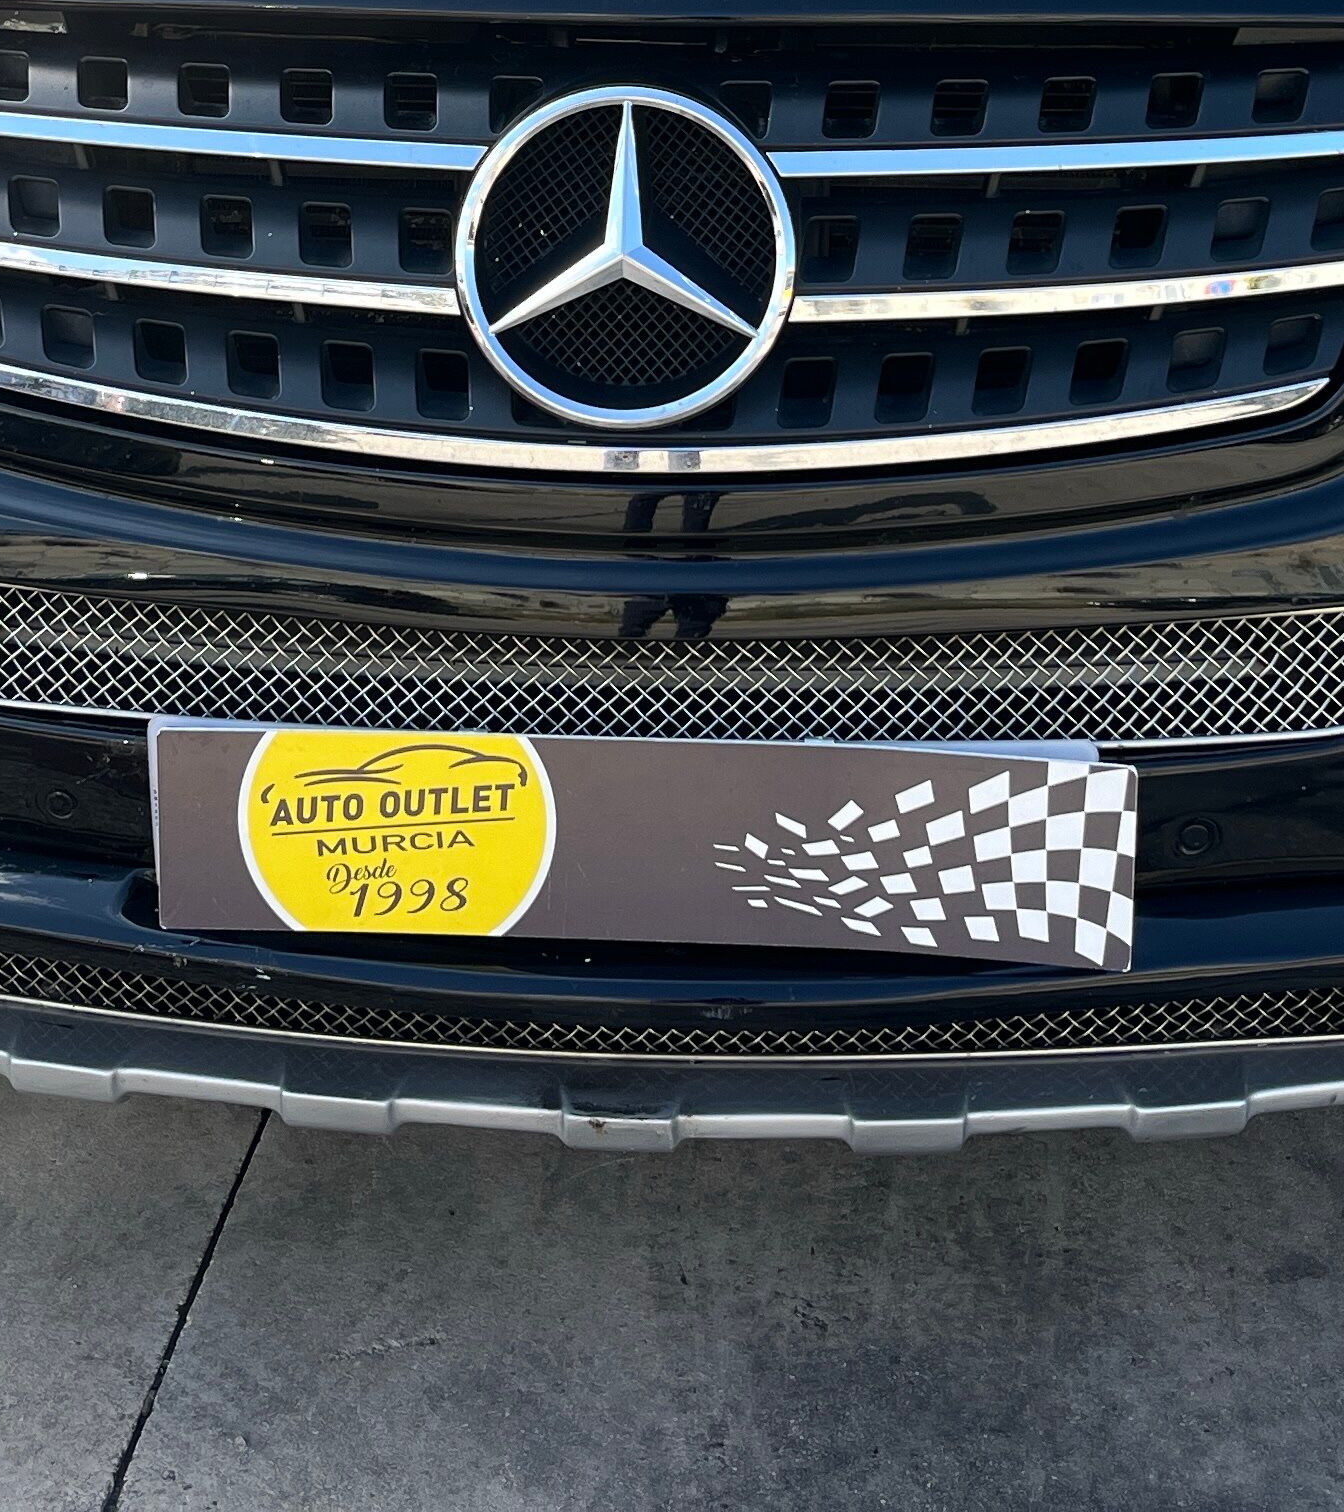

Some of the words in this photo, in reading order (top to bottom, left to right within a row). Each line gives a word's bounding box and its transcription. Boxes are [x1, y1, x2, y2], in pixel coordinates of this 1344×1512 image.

[269, 792, 364, 827] AUTO
[379, 783, 516, 819] OUTLET
[316, 829, 475, 857] MURCIA
[326, 858, 397, 895] Desde
[349, 877, 469, 918] 1998
